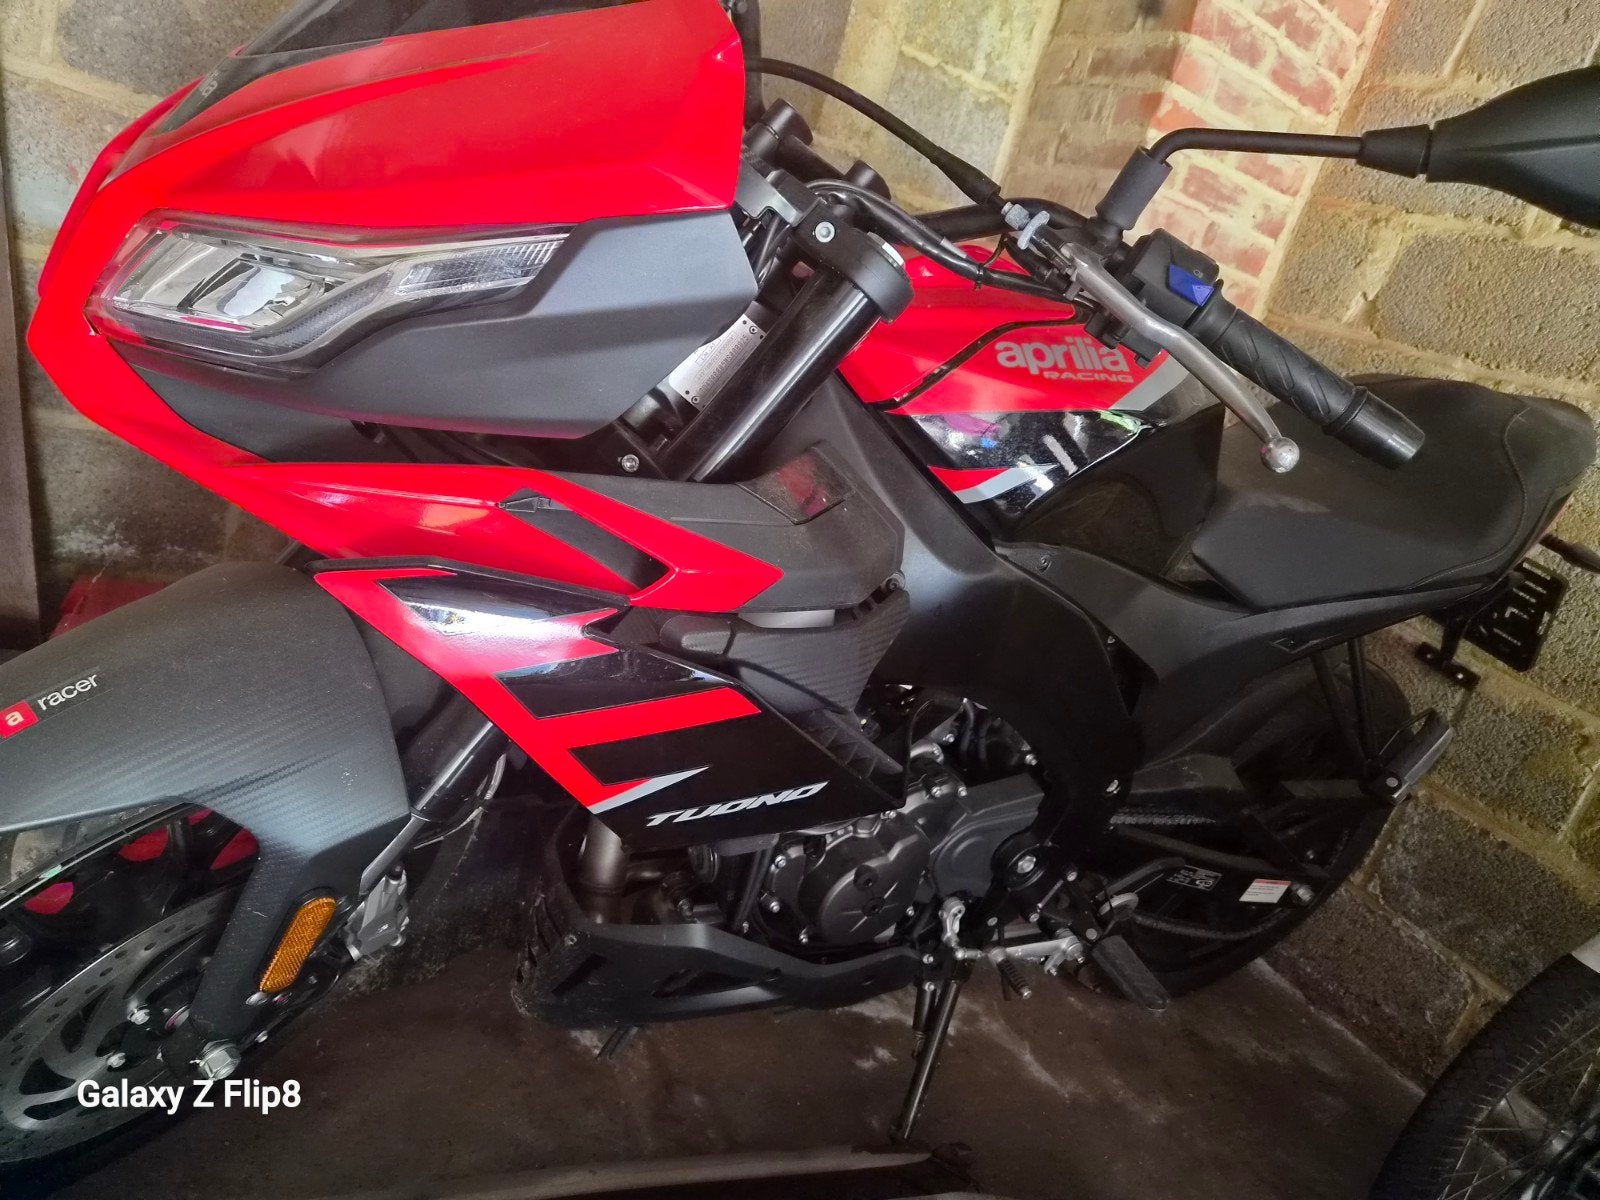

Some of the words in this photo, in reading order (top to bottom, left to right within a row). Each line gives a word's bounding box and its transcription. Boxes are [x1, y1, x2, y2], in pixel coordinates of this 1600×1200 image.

[994, 336, 1130, 375] aprilia
[1042, 371, 1134, 384] RACING
[37, 674, 98, 711] racer
[646, 780, 828, 827] TUONO
